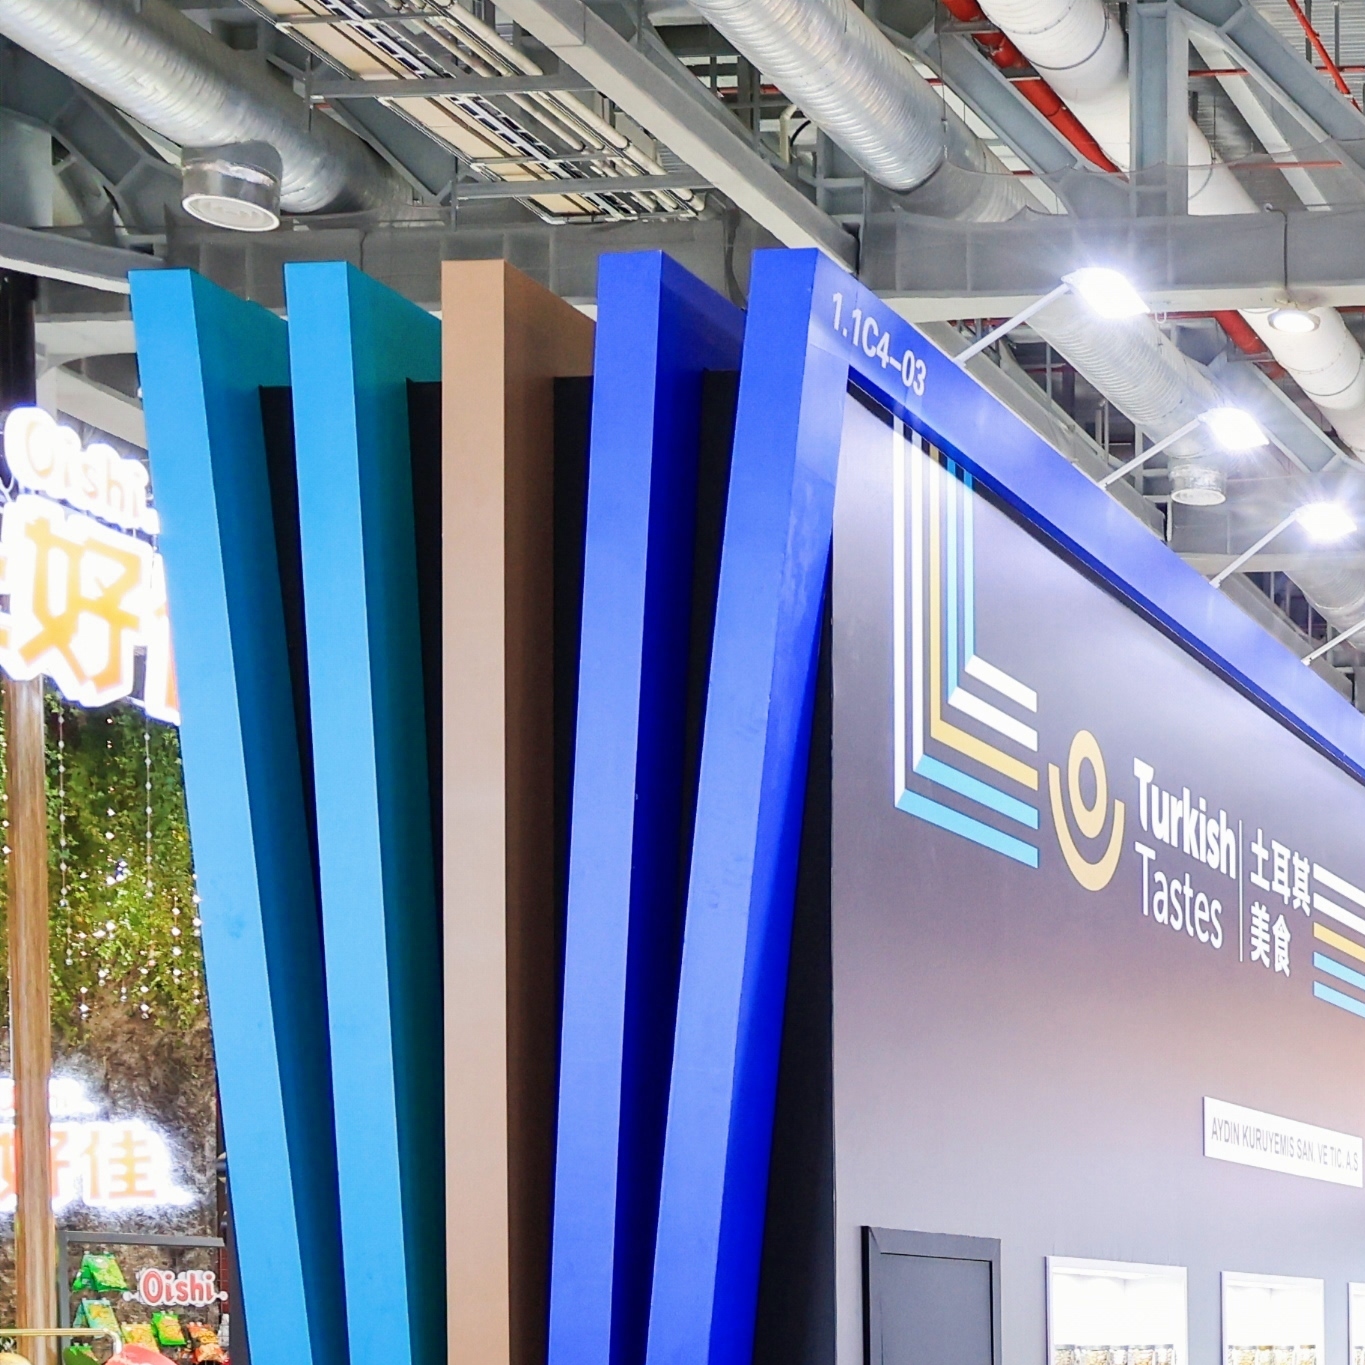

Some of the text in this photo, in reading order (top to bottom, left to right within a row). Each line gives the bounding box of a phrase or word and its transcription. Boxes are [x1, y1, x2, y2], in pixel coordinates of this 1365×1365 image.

[833, 292, 926, 396] 1.1C4-03
[1134, 757, 1236, 880] Turkish
[1135, 841, 1223, 949] Tastes
[1251, 828, 1311, 917] 土耳其
[1251, 902, 1291, 977] 美食
[1211, 1117, 1240, 1146] AYDIN
[1242, 1125, 1295, 1158] KURUYEMIS
[1318, 1143, 1328, 1165] VE
[142, 1270, 216, 1304] Oishi
